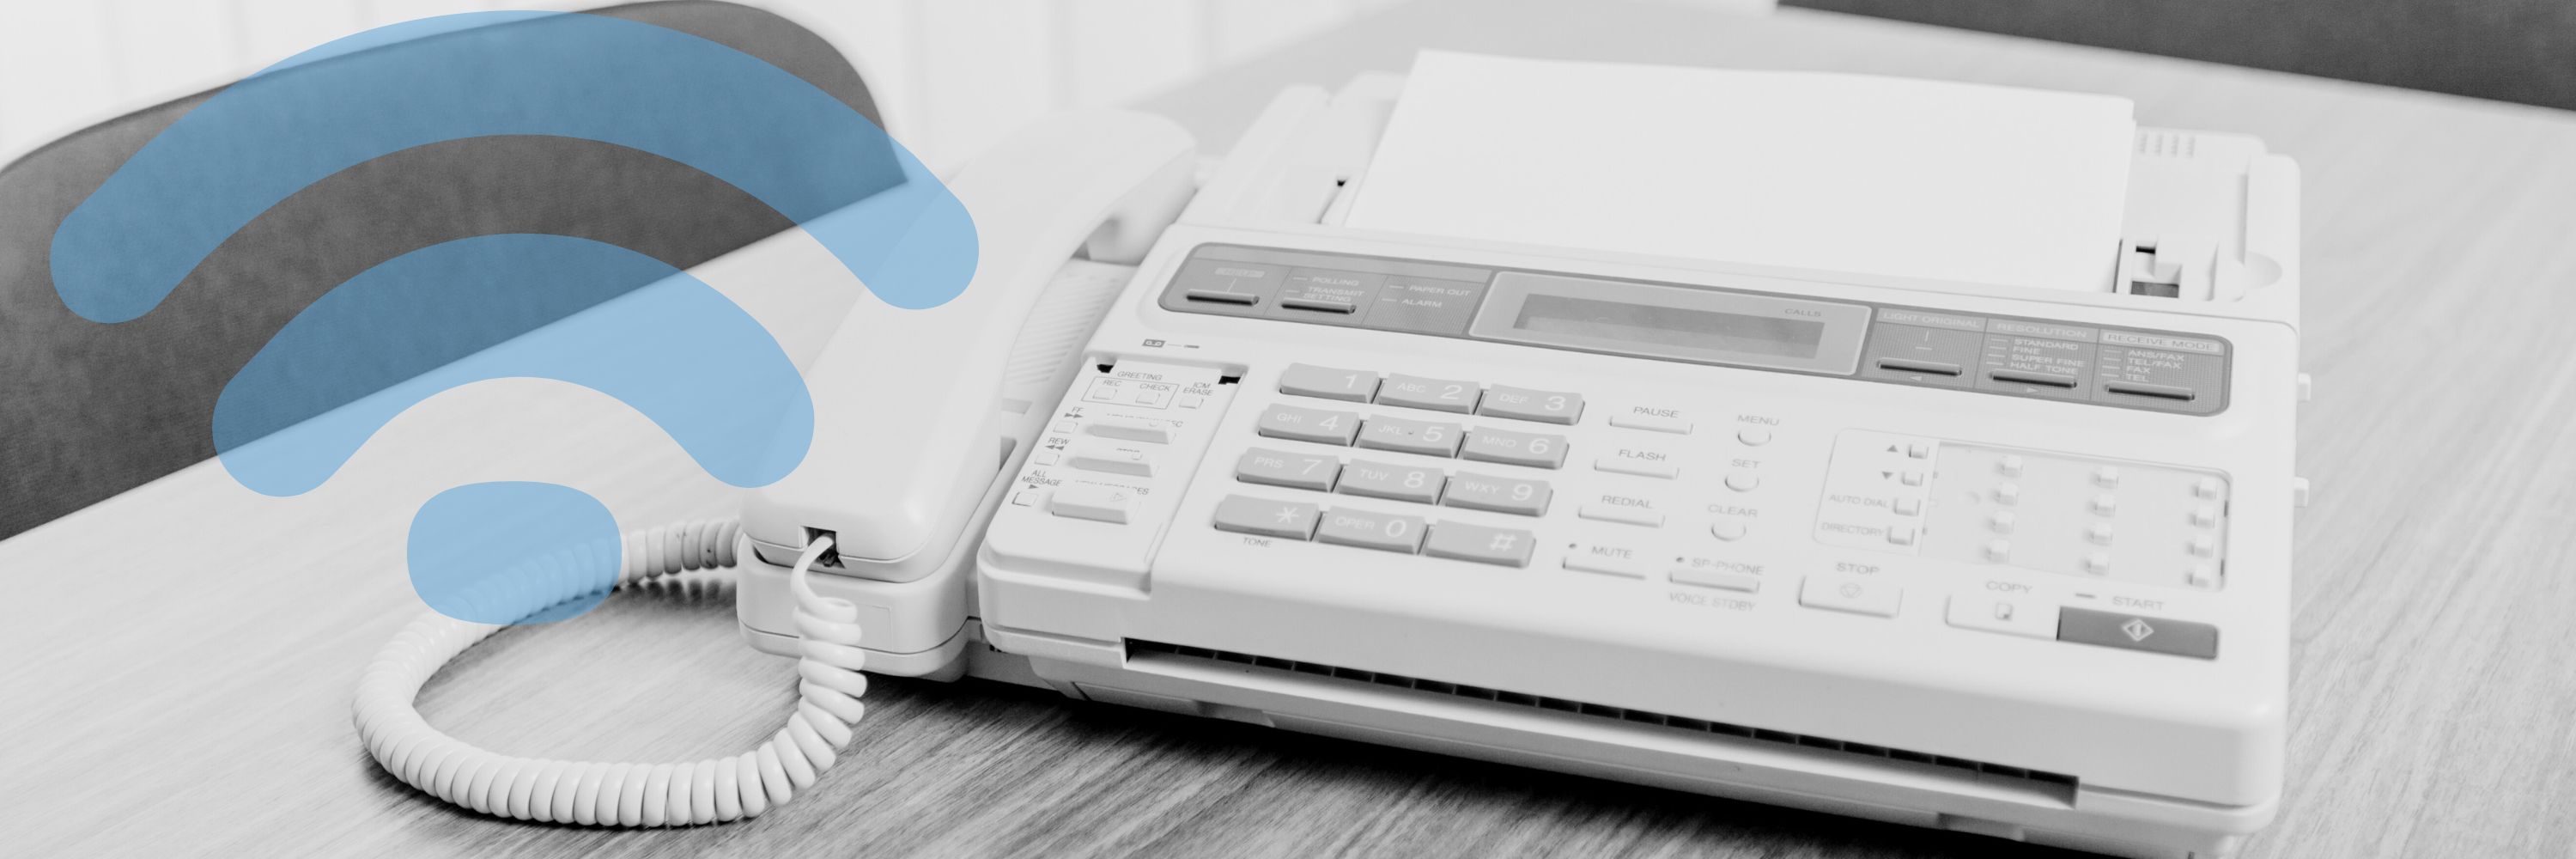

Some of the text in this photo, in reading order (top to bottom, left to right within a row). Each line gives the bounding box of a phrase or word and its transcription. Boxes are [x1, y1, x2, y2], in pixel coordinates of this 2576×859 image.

[1312, 277, 1359, 286] POLLING
[1309, 286, 1365, 297] TRANSMIT
[1409, 284, 1445, 294] PAPER
[1303, 293, 1352, 302] SETTING
[1401, 299, 1443, 308] ALARM
[1784, 308, 1821, 317] CALLS
[1883, 312, 1979, 328] LIGHT ORIGINAL
[1997, 323, 2087, 338] RESOLUTION
[2014, 338, 2079, 350] STANDARD
[2108, 334, 2214, 350] RECEIVE MODE
[2013, 346, 2040, 355] FINE
[2128, 350, 2184, 362] ANS/FAX
[2012, 354, 2087, 367] SUPER FINE
[2127, 357, 2182, 369] TEL/FAX
[1117, 371, 1162, 381] GREETING
[2046, 365, 2079, 375] TONE
[1345, 374, 1357, 389] 1
[2125, 374, 2149, 382] TEL
[1139, 383, 1170, 393] CHECK
[1183, 387, 1213, 397] ERASE
[1397, 382, 1462, 400] ABC 2
[1498, 393, 1567, 411] DEF 3
[1632, 406, 1680, 418] PAUSE
[1277, 413, 1339, 431] GHI 4
[1737, 414, 1780, 426] MENU
[1378, 424, 1446, 442] JKL 5
[1048, 437, 1069, 446] REW
[1482, 435, 1551, 454] MNO 6
[1618, 449, 1667, 462] FLASH
[1255, 456, 1323, 475] PRS 7
[1731, 458, 1761, 470] SET
[1022, 476, 1063, 487] MESSAGE
[1359, 468, 1426, 489] TUV 8
[1465, 481, 1533, 501] WXY 9
[1601, 495, 1653, 509] REDIAL
[1828, 494, 1889, 509] AUTO DIAL
[1707, 504, 1759, 518] CLEAR
[1335, 516, 1375, 531] OPER
[1820, 521, 1884, 537] DIRECTORY
[1243, 536, 1271, 549] TONE
[1491, 533, 1518, 551] #
[1591, 545, 1634, 559] MUTE
[1692, 557, 1765, 576] SP-PHONE
[1836, 561, 1880, 576] STOP
[1985, 580, 2033, 594] COPY
[1668, 592, 1757, 612] VOICE STDBY
[2112, 594, 2165, 611] START
